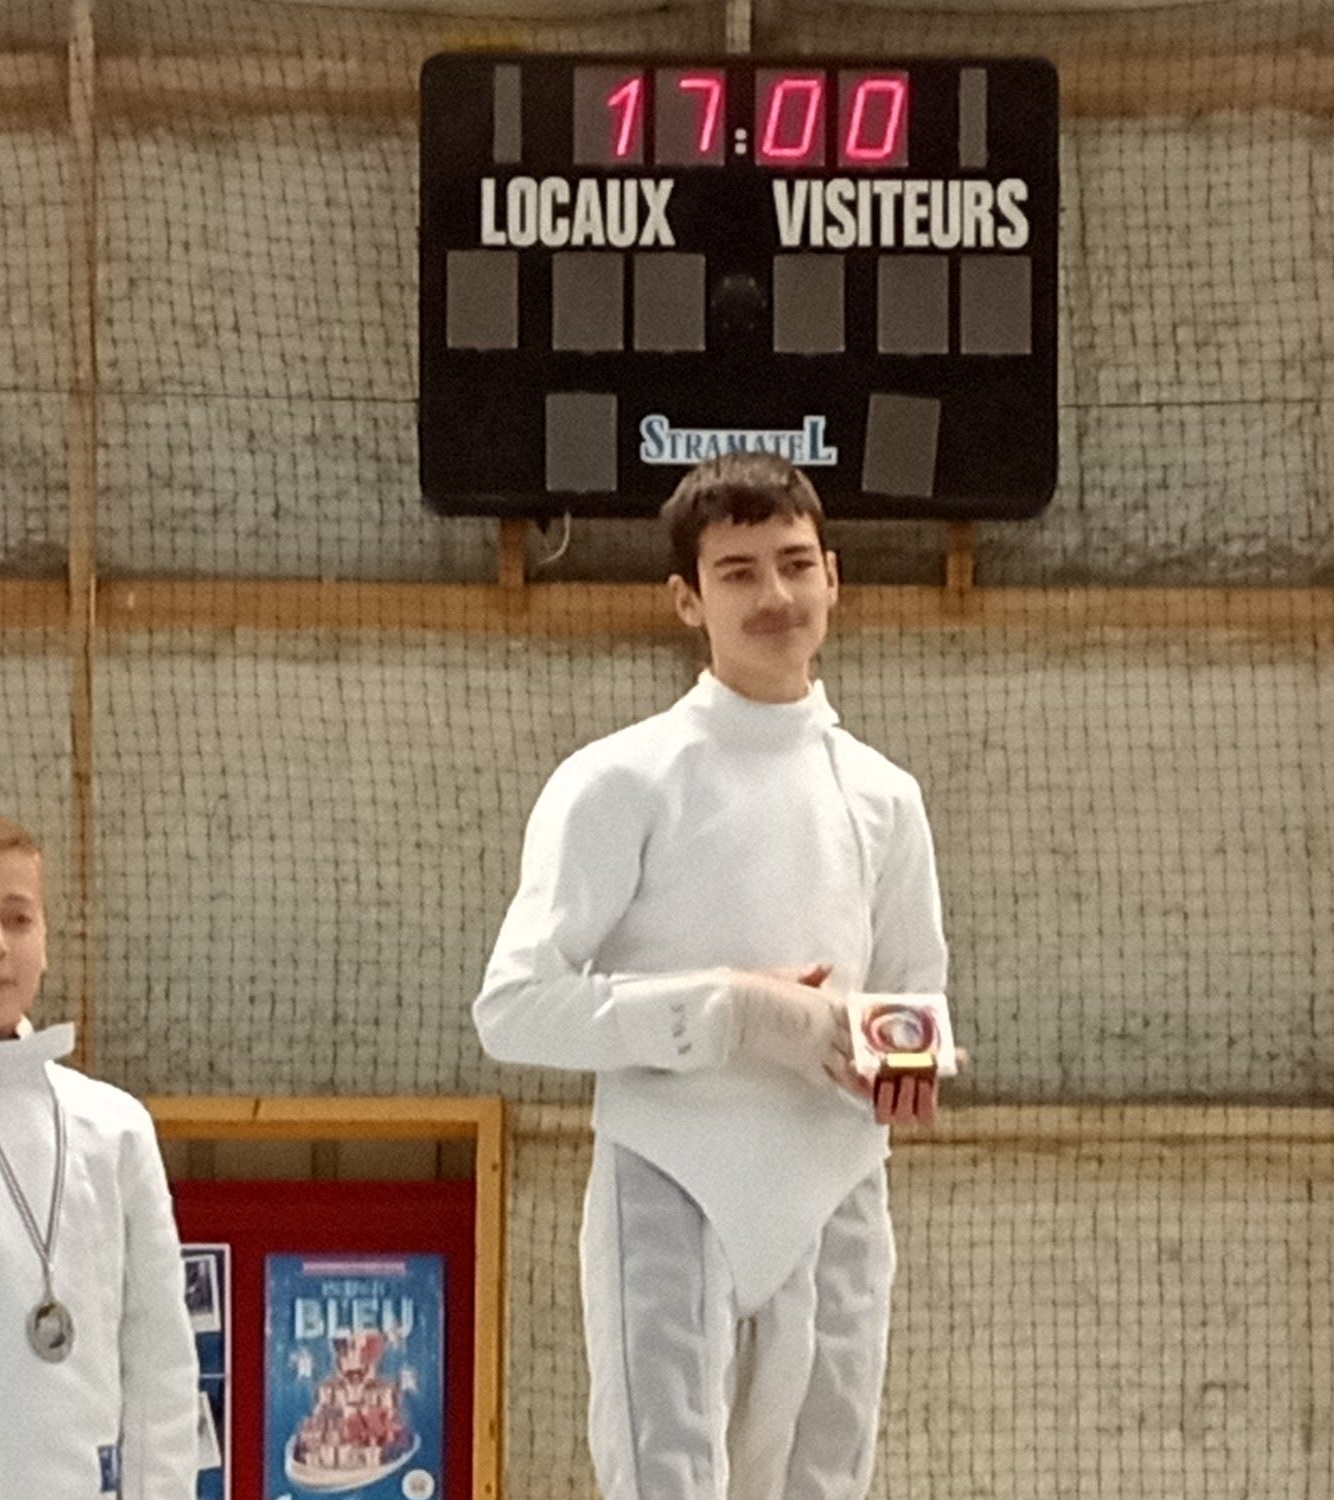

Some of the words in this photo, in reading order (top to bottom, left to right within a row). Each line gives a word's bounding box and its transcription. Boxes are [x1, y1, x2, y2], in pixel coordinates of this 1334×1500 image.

[607, 77, 906, 159] 17:00
[480, 176, 676, 247] LOCAUX
[772, 177, 1029, 248] VISITEURS
